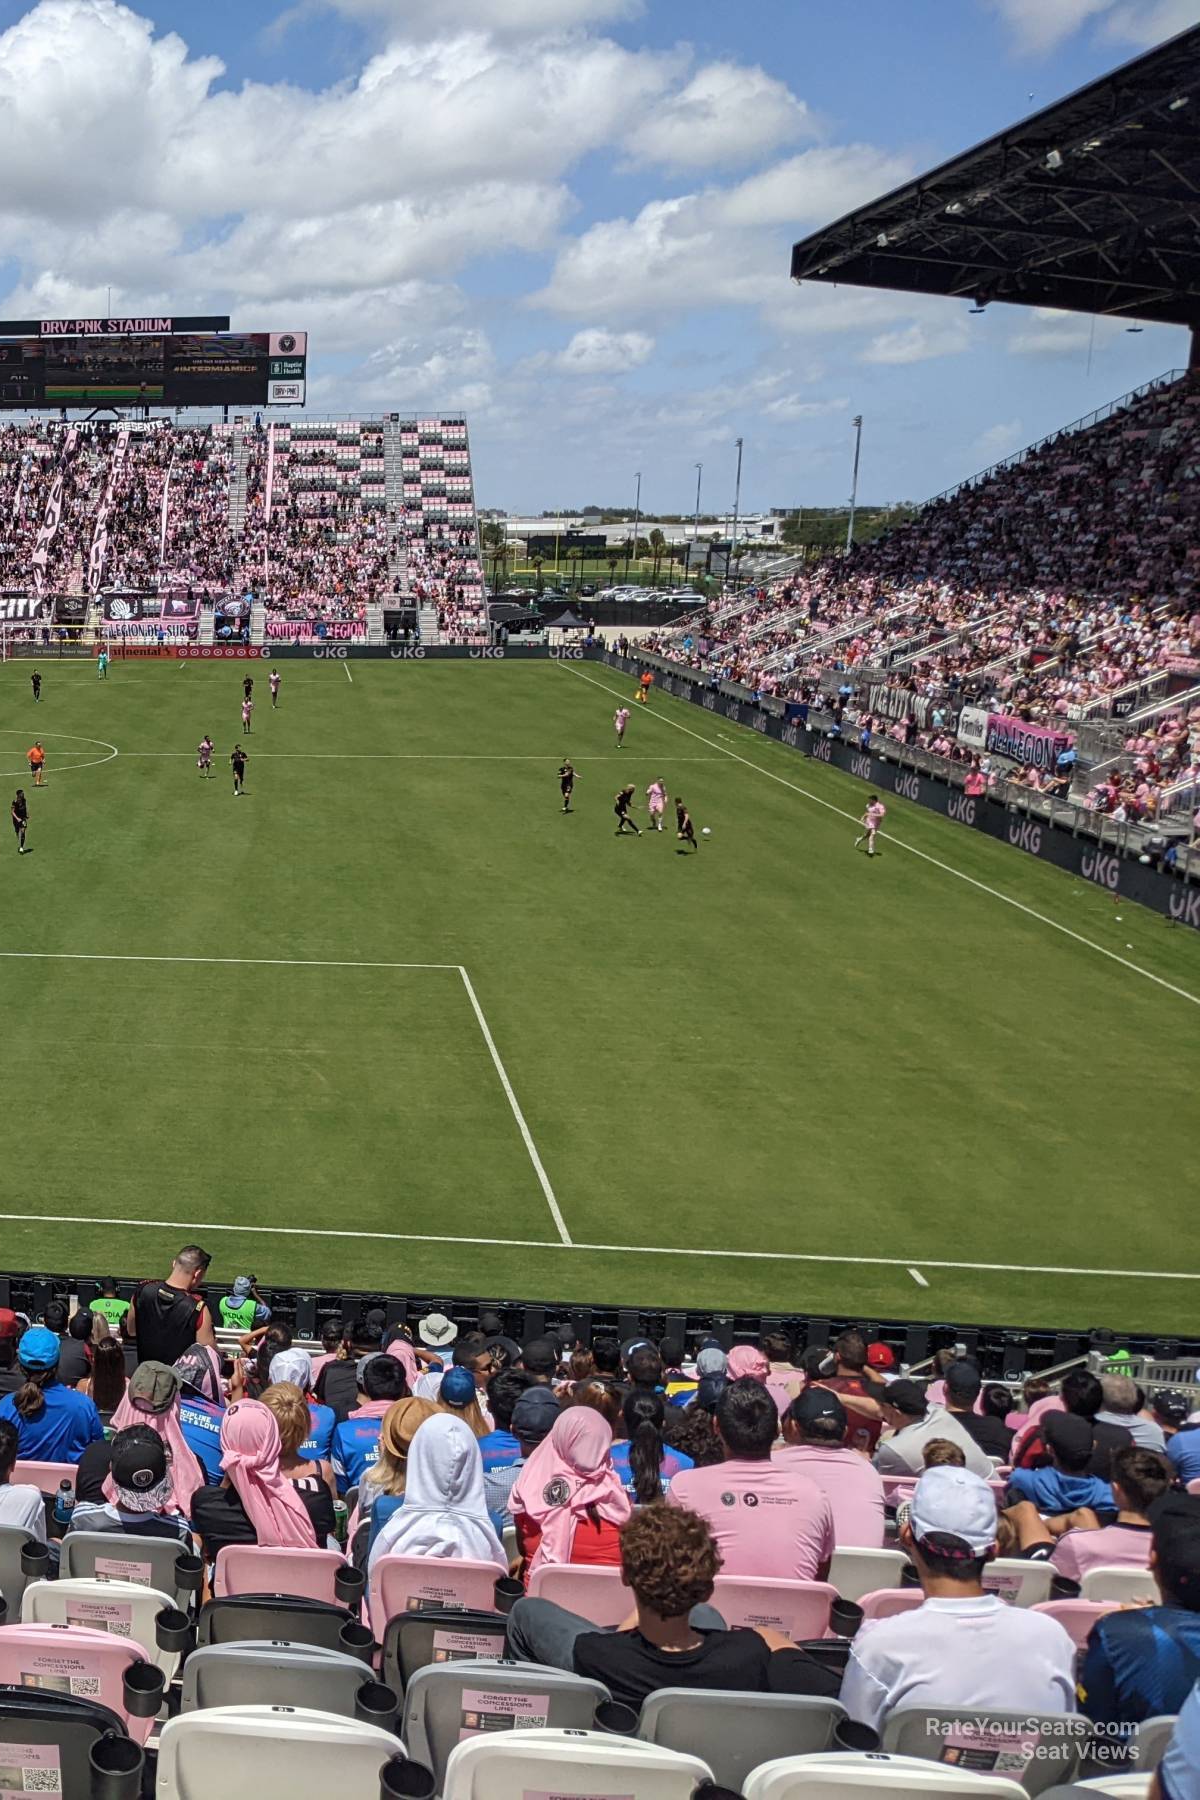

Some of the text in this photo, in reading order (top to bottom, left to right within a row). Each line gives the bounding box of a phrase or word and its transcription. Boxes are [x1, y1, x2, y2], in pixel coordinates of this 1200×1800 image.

[41, 319, 172, 334] DRV PNK STADIUM
[166, 624, 186, 637] SUR
[266, 623, 365, 638] SOUTHERN EGION
[313, 646, 348, 658] UKG
[390, 646, 426, 658] UKG
[469, 646, 504, 658] UKG
[548, 646, 584, 659] UKG
[1116, 703, 1131, 712] 117
[813, 738, 831, 762] UKG
[1010, 725, 1052, 769] LEGION
[850, 755, 871, 780] UKG
[894, 773, 920, 801] UKG
[947, 794, 976, 826] UKG
[1009, 819, 1042, 854] UKG
[1081, 850, 1120, 889] UKG
[1169, 884, 1200, 927] UK
[222, 1311, 244, 1321] MEDIA
[477, 1700, 533, 1708] CONCESSIONS
[482, 1694, 513, 1702] FORGET
